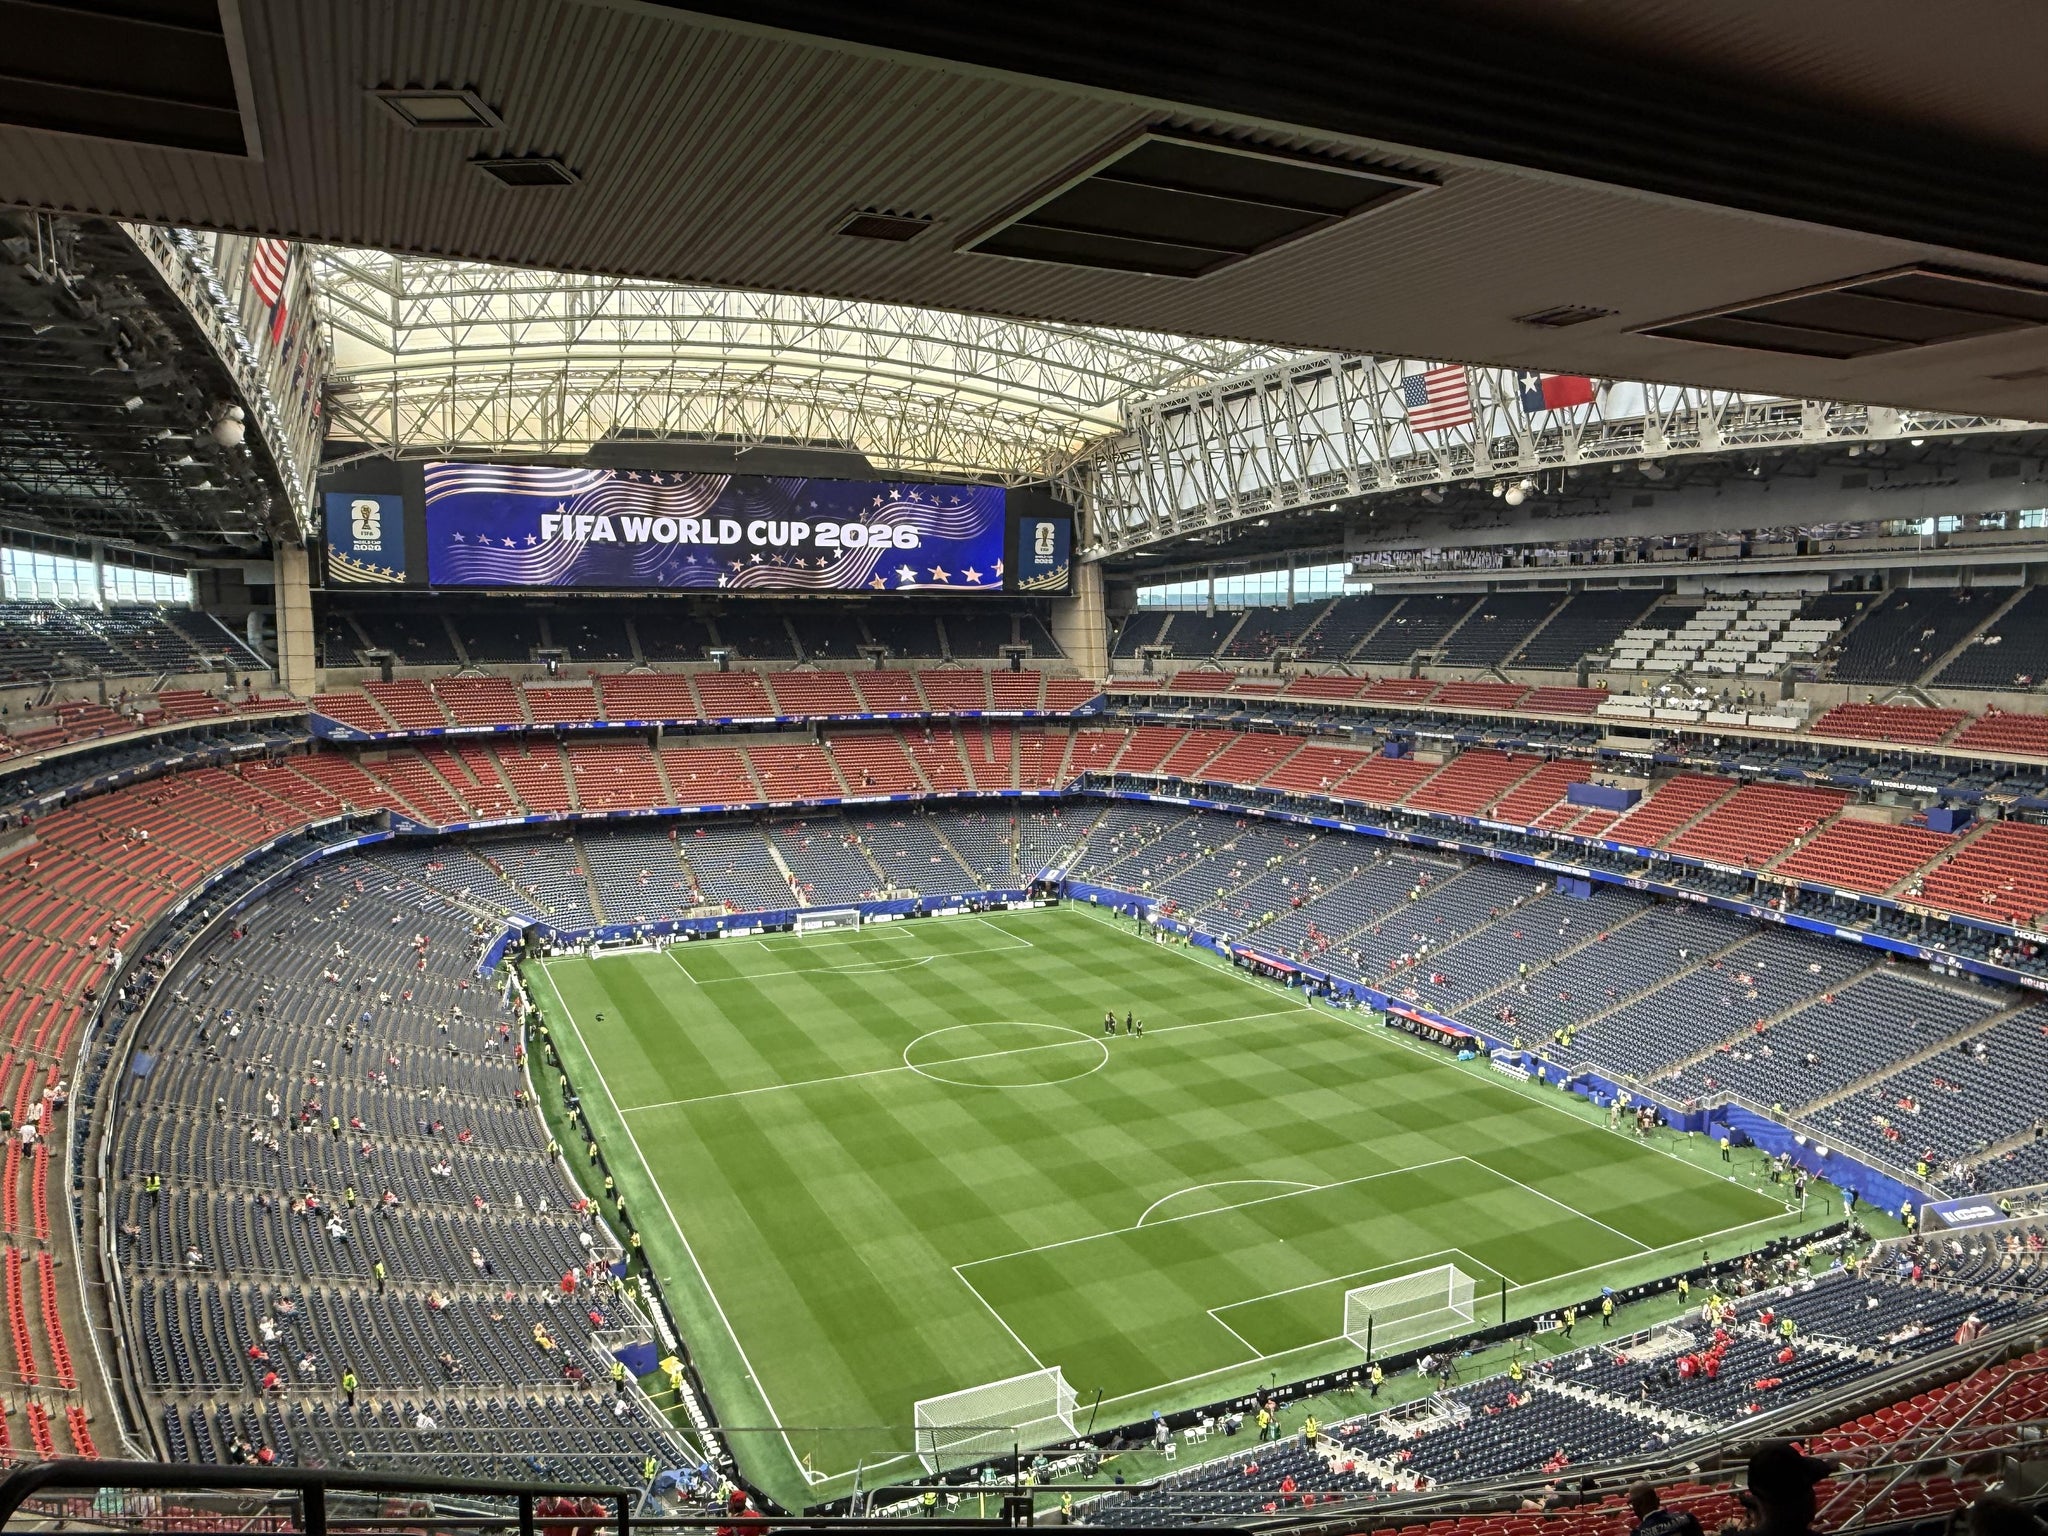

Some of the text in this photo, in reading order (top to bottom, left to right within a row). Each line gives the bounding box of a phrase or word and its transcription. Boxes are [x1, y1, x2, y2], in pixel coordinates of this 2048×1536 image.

[541, 514, 920, 549] FIFA WORLD CUP 2026
[1619, 751, 1653, 760] HOUSTON
[1870, 779, 1884, 787] FIFA
[1884, 781, 1905, 789] WORLD
[1905, 783, 1917, 791] CUP
[1703, 862, 1742, 875] HOUSTON
[2014, 929, 2048, 943] HOUS
